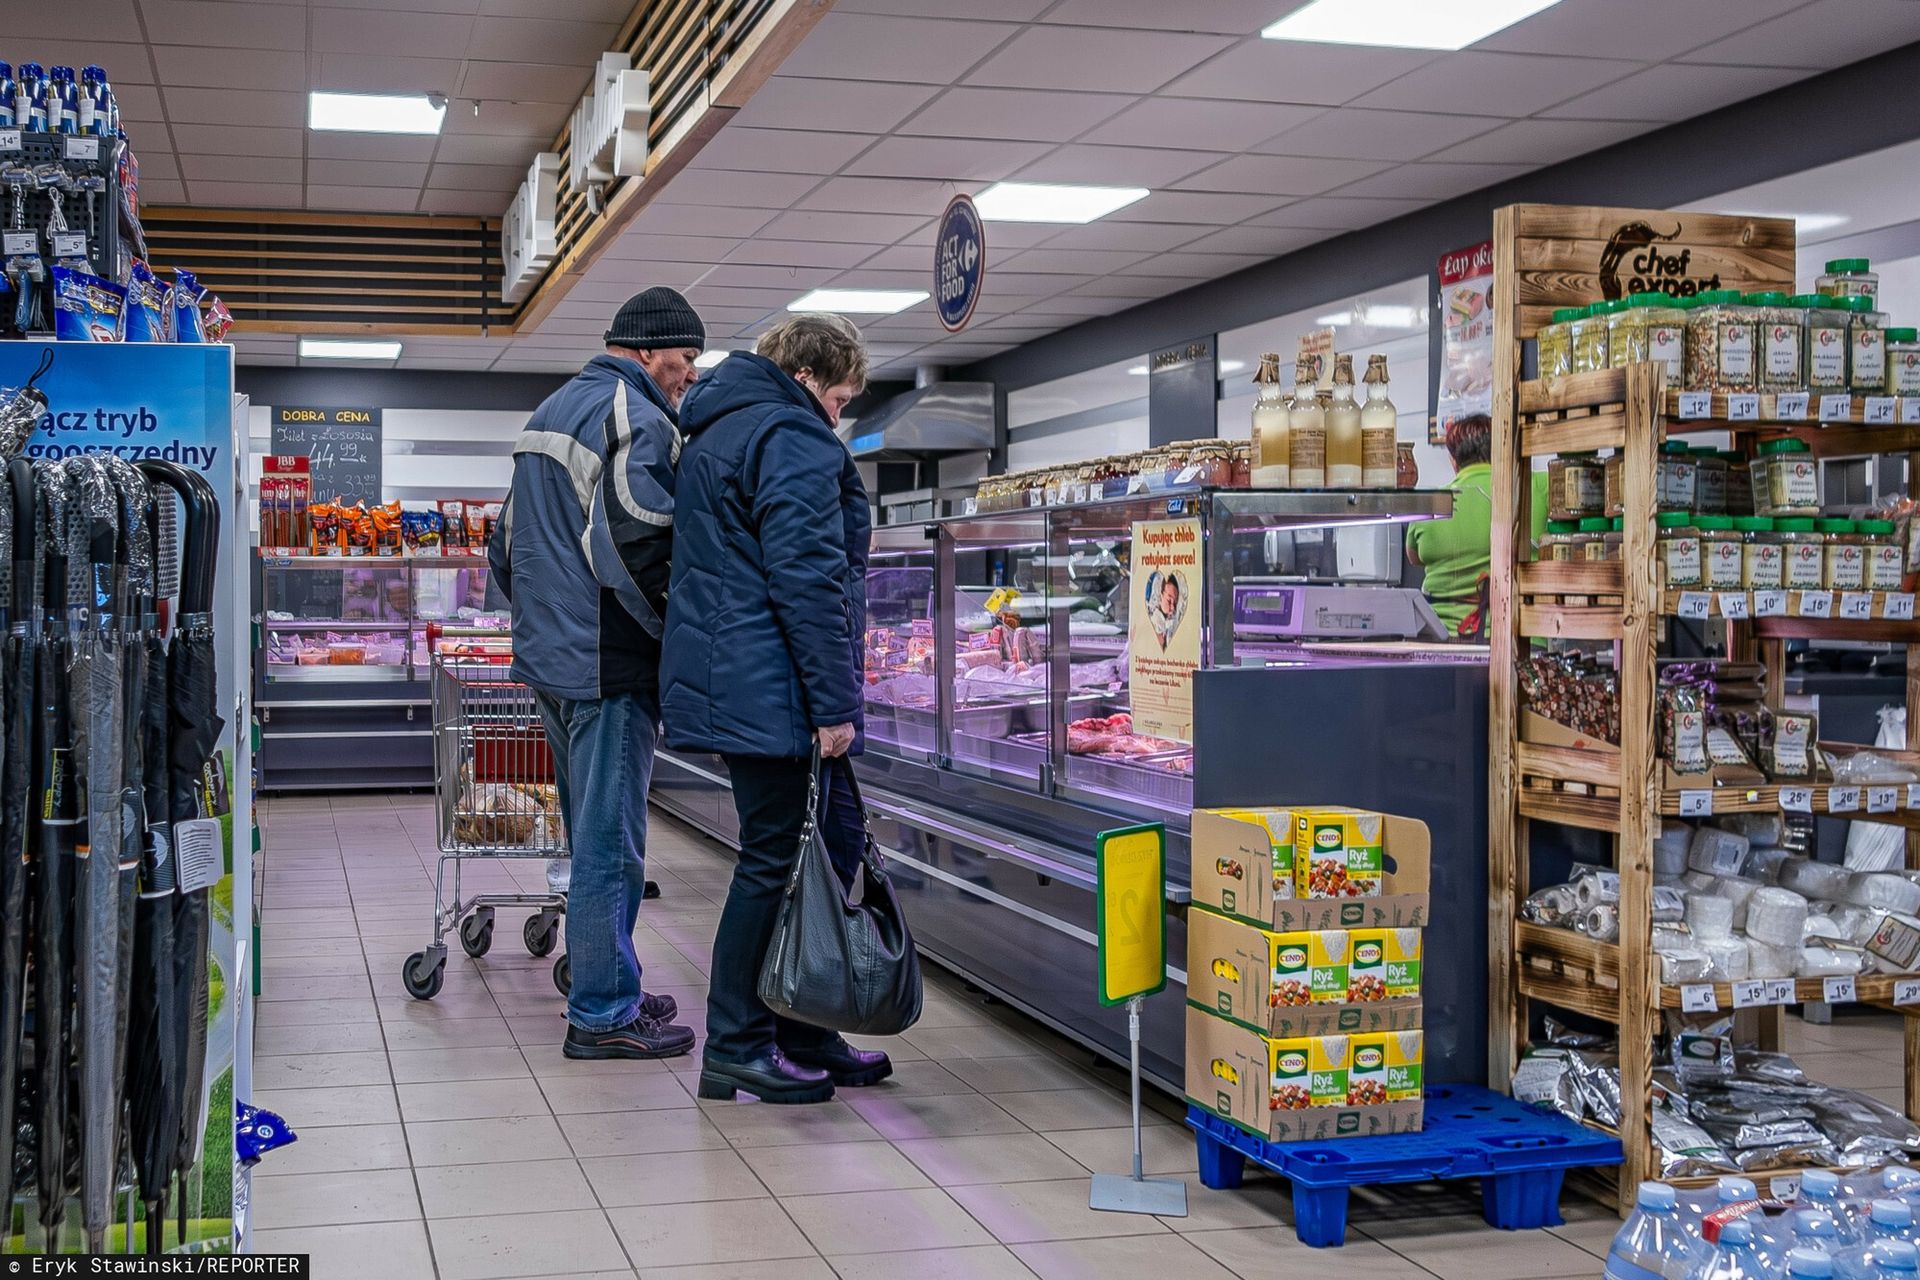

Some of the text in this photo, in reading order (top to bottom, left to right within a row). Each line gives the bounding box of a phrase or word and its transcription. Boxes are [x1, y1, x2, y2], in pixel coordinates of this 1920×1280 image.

[942, 233, 960, 261] ACT
[1633, 246, 1691, 277] chef
[941, 259, 959, 283] FOR
[942, 275, 965, 303] FOOD
[94, 407, 157, 437] tryb
[282, 410, 370, 422] DOBRA CENA
[277, 456, 296, 466] JBB
[1142, 525, 1195, 547] Kupując chleb
[1141, 548, 1196, 569] ratujesz serce!
[1349, 849, 1368, 863] Ryż
[1313, 968, 1333, 984] Ryż
[1388, 963, 1407, 978] Ryż
[1313, 1073, 1333, 1089] Ryż
[1389, 1067, 1408, 1083] Ryż
